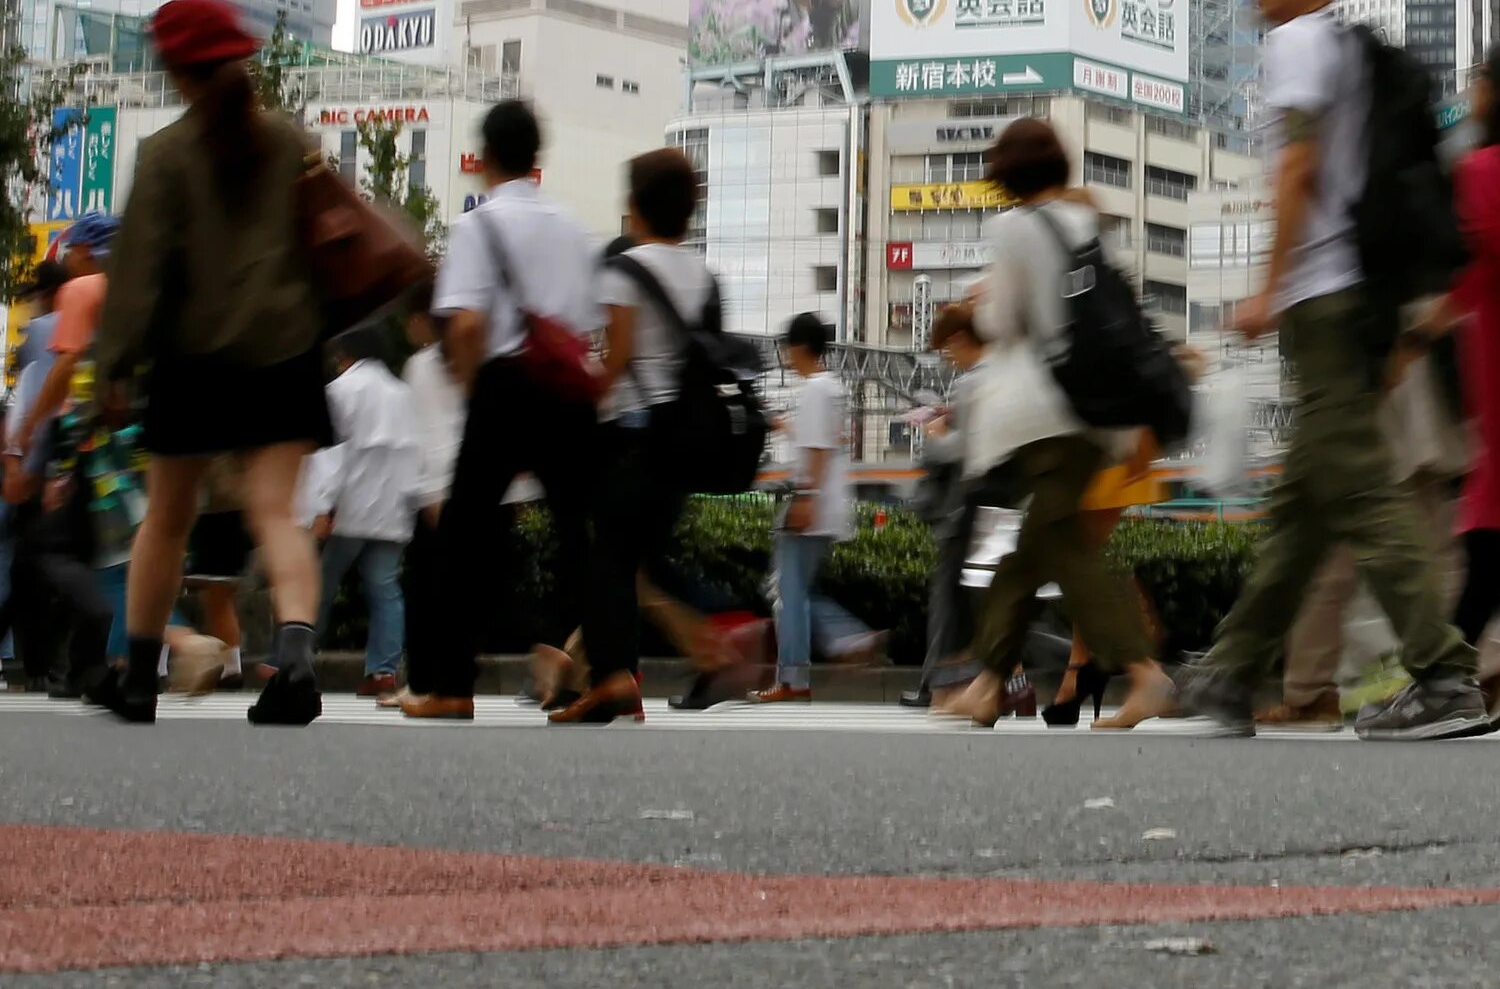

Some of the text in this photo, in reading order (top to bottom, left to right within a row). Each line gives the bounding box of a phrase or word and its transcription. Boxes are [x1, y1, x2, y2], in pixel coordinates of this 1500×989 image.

[361, 15, 433, 55] ODAKYU
[1121, 2, 1175, 43] 英会話
[895, 59, 996, 92] 新宿本校
[1134, 78, 1181, 109] 全国200校
[321, 106, 430, 125] BIC CAMERA
[892, 247, 909, 263] 7F
